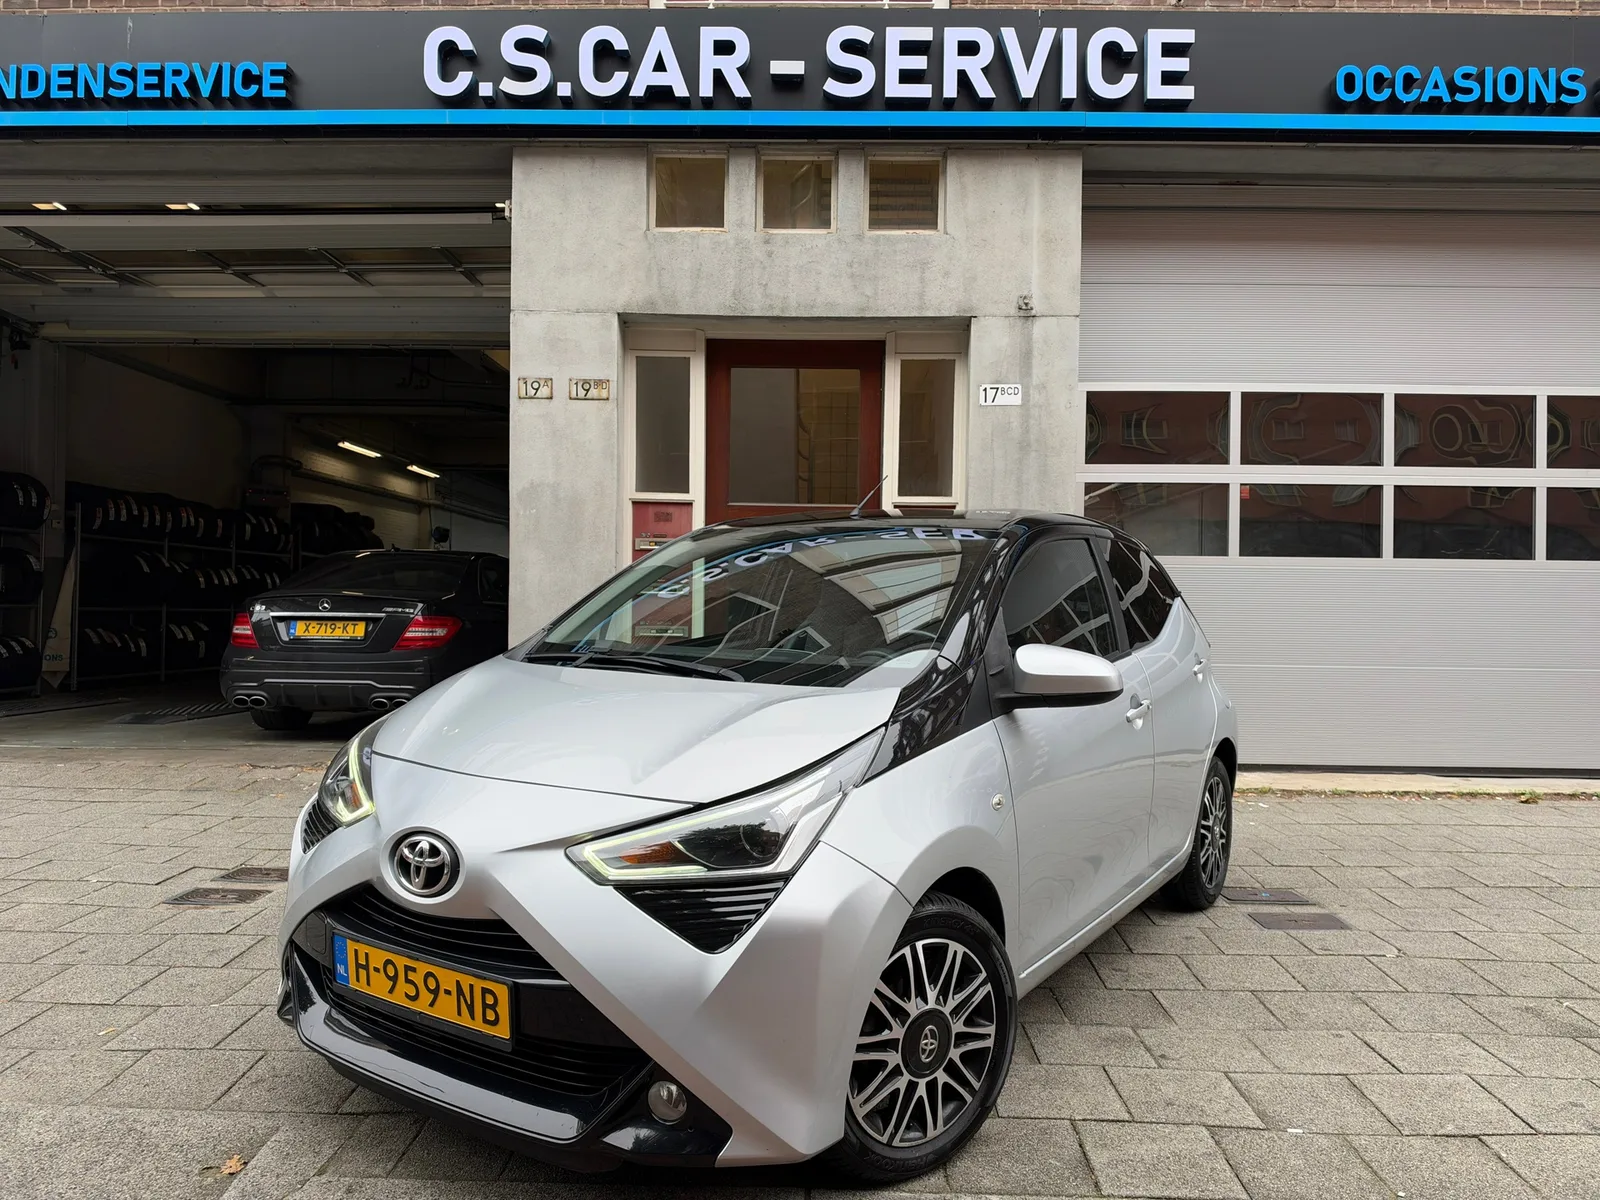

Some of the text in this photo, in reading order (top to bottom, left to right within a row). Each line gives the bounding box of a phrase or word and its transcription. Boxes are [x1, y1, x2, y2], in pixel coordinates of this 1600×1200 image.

[0, 61, 288, 99] NDENSERVICE
[423, 24, 752, 98] C.S.CAR
[822, 25, 1196, 100] SERVICE
[1335, 64, 1588, 104] OCCASIONS
[303, 622, 359, 635] X-719-KT
[336, 948, 500, 1027] NL H-959-NB
